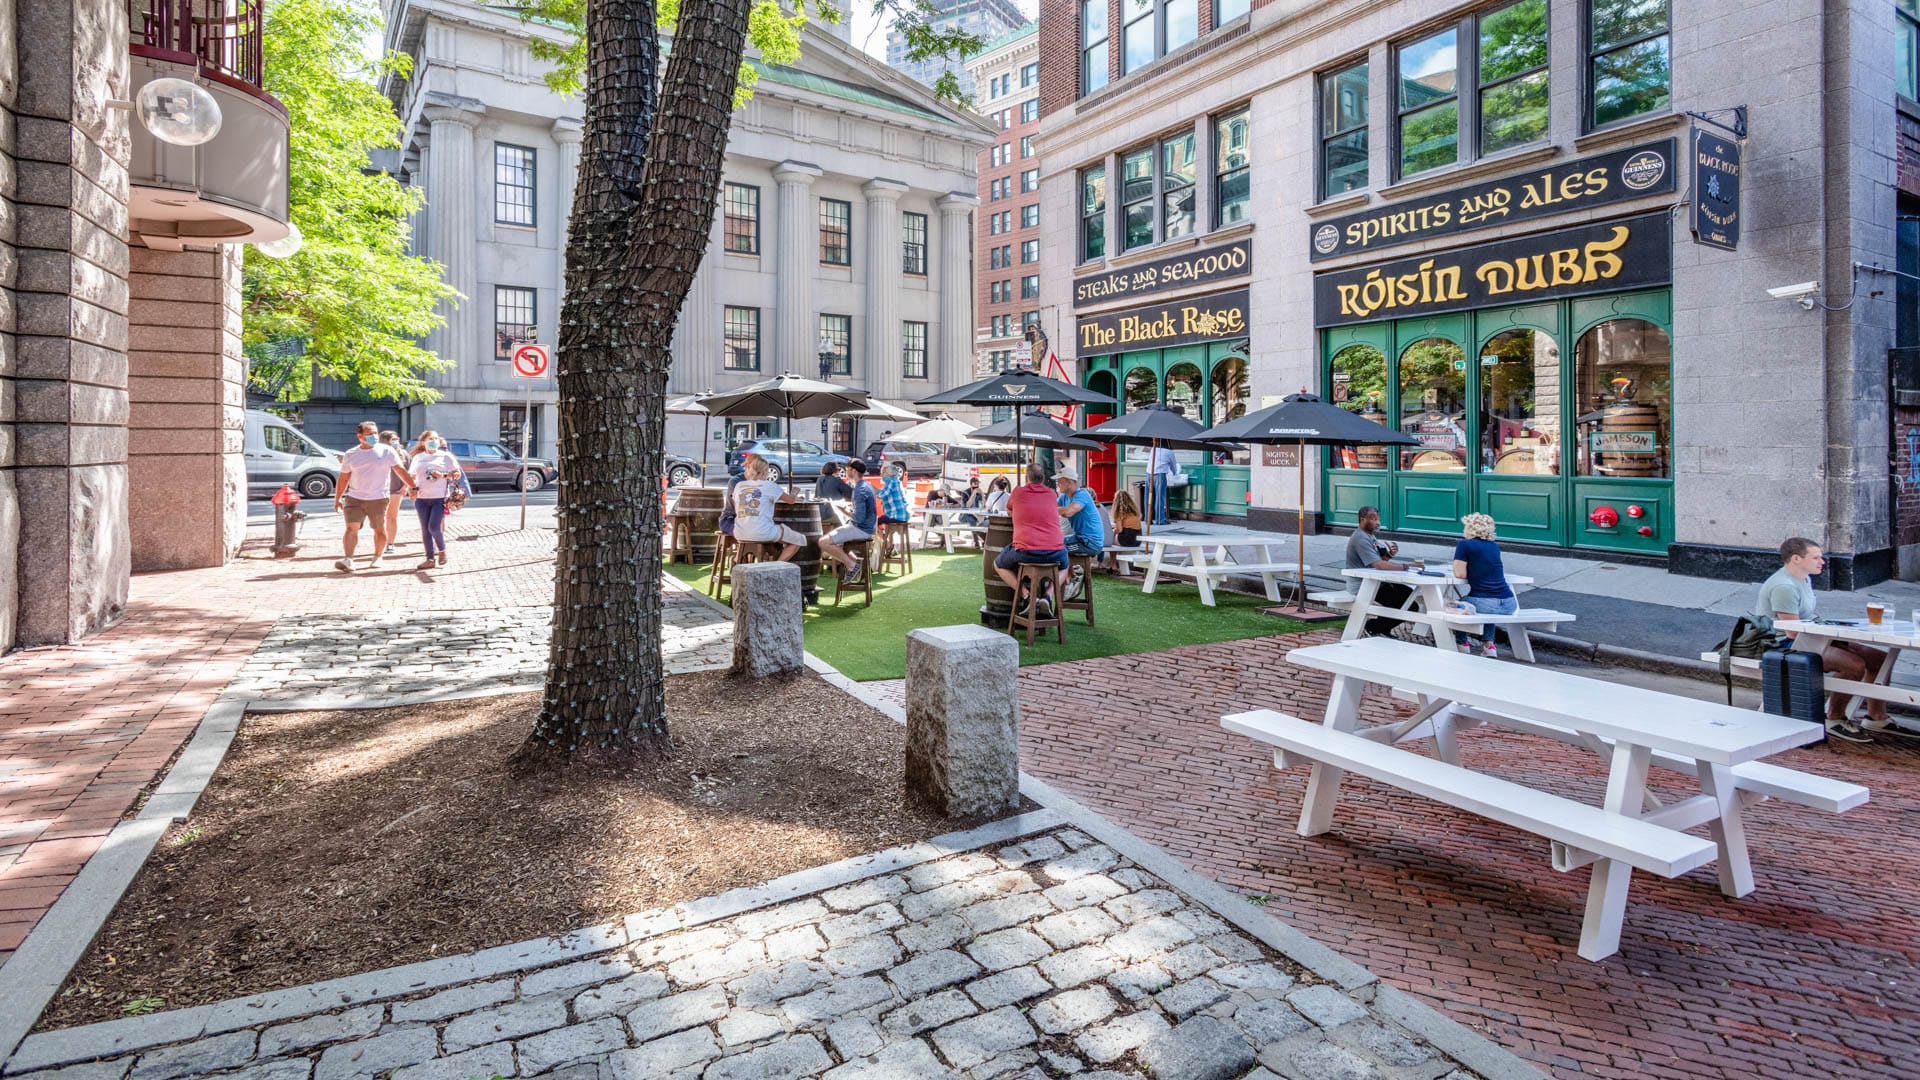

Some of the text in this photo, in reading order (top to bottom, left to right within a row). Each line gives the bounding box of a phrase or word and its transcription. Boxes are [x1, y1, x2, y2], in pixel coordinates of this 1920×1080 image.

[1624, 162, 1663, 174] GUINNESS
[1346, 168, 1609, 247] SPIRITS AND ALES
[1078, 247, 1247, 301] STEAKS AND SEAFOOD
[1336, 226, 1631, 317] RÓISÍN DUBH
[1080, 322, 1116, 349] The
[1119, 310, 1177, 344] Black
[1265, 451, 1295, 459] NIGHTS A
[1595, 433, 1649, 447] JAMESON
